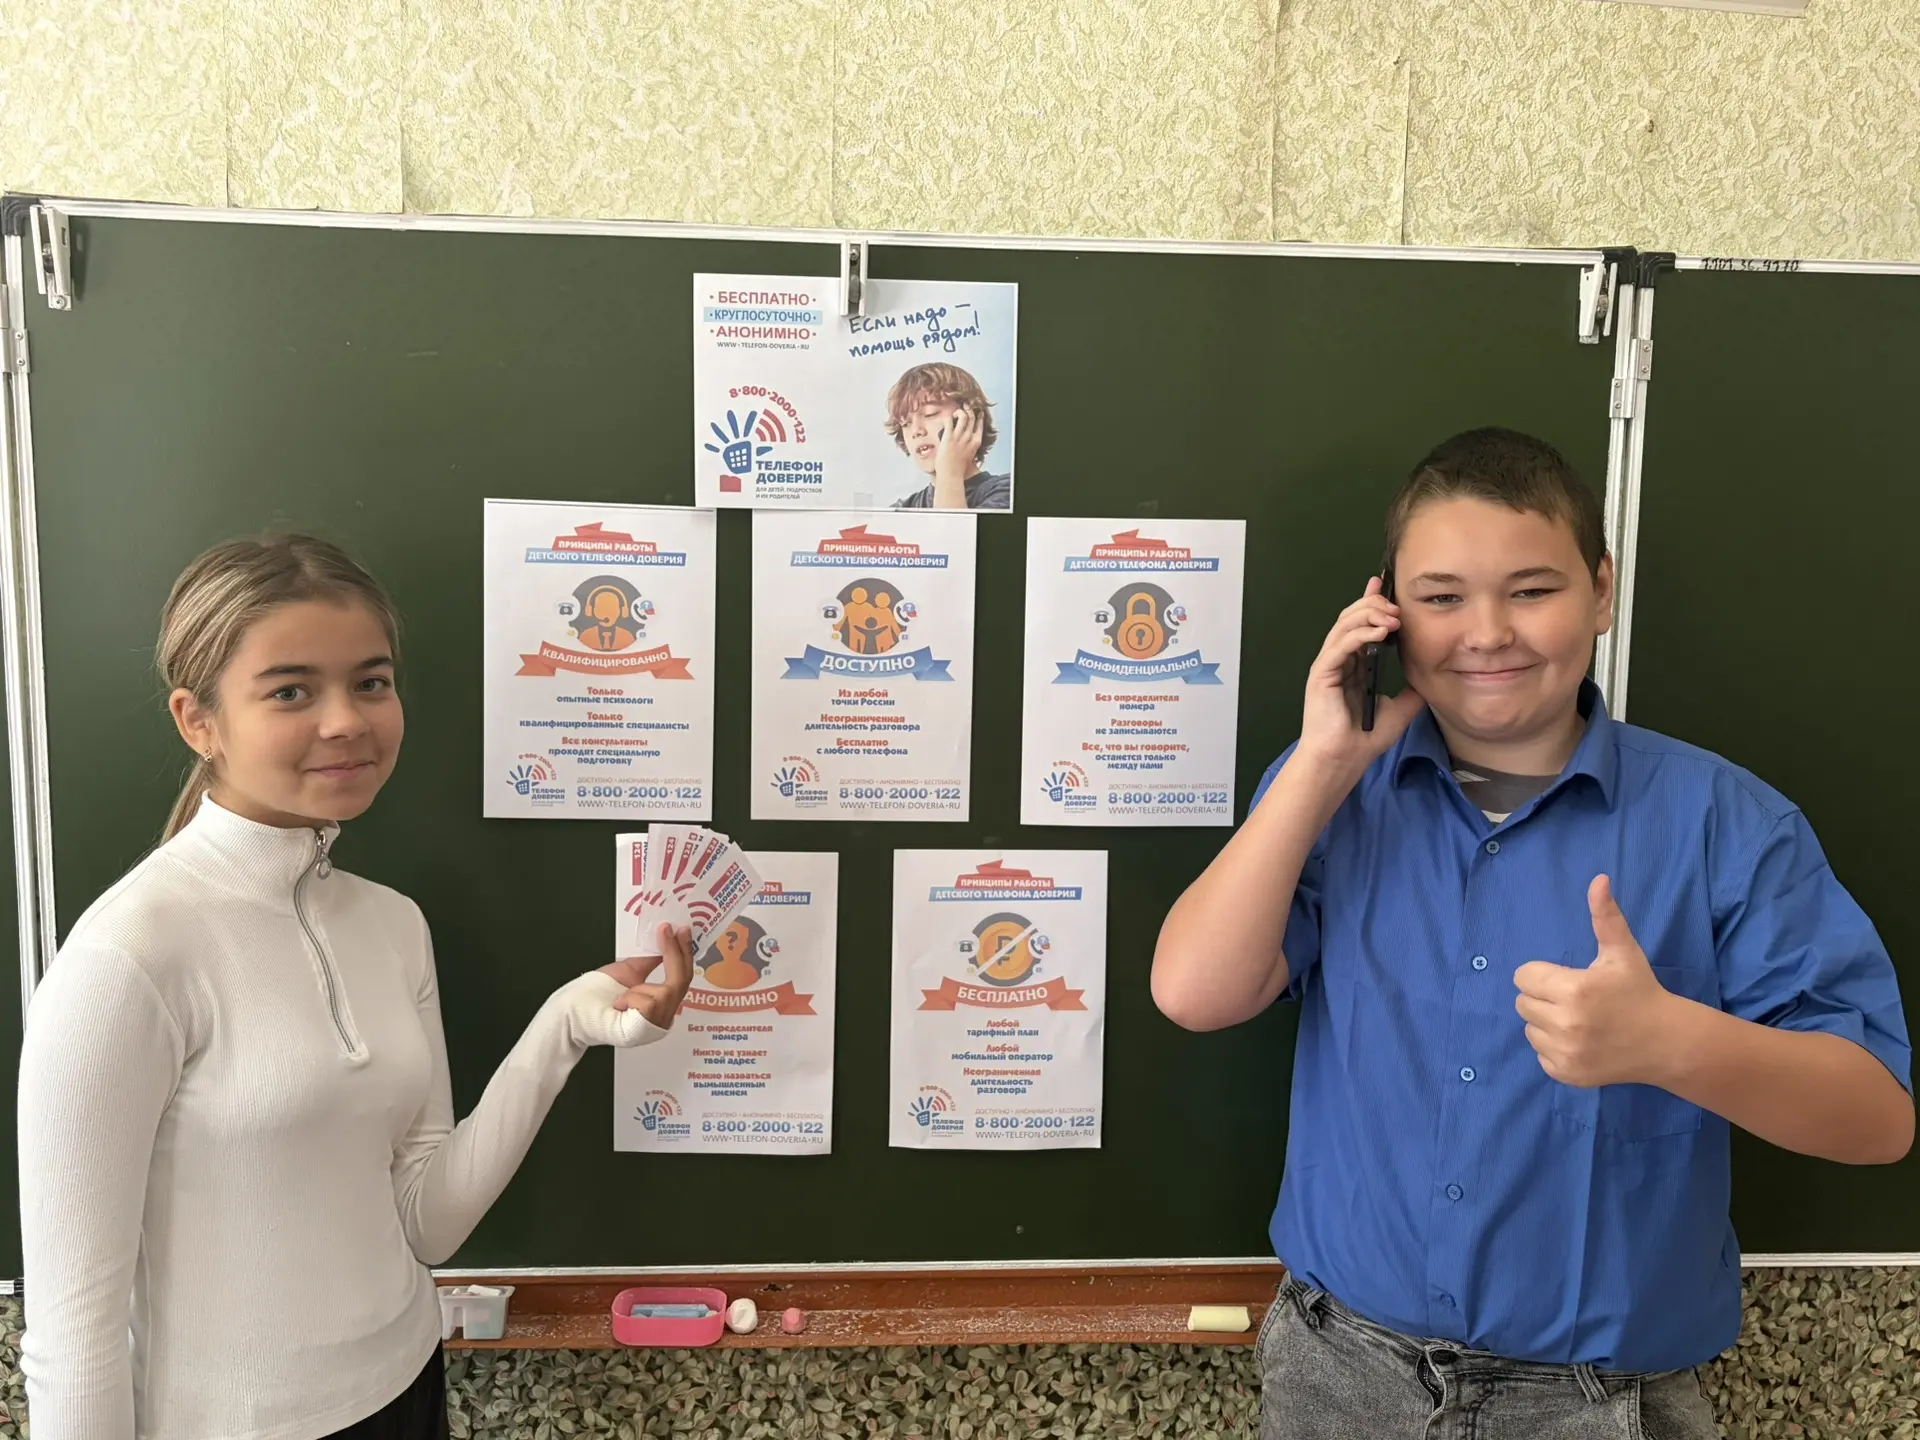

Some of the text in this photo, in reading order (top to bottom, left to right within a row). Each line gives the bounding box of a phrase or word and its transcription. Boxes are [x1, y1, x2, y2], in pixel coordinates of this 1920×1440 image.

[719, 292, 809, 305] БЕСПЛАТНО
[715, 310, 811, 322] КРУГЛОСУТОЧНО
[849, 316, 896, 333] Если
[904, 307, 946, 331] надо
[717, 326, 810, 339] АНОНИМНО
[850, 311, 980, 357] помощь рядом!
[756, 461, 822, 471] ТЕЛЕФОН
[756, 473, 822, 484] ДОВЕРИЯ
[559, 541, 653, 552] ПРИНЦИПЫ РАБОТЫ
[824, 544, 916, 554] ПРИНЦИПЫ РАБОТЫ
[528, 552, 683, 564] ДЕТСКОГО ТЕЛЕФОНА ДОВЕРИЯ
[1096, 549, 1187, 558] ПРИНЦИПЫ РАБОТЫ
[794, 555, 945, 566] ДЕТСКОГО ТЕЛЕФОНА ДОВЕРИЯ
[1070, 561, 1212, 570] ДЕТСКОГО ТЕЛЕФОНА ДОВЕРИЯ
[543, 648, 668, 668] КВАЛИФИЦИРОВАННО
[820, 655, 915, 671] ДОСТУПНО
[1078, 657, 1198, 675] КОНФИДЕНЦИАЛЬНО
[587, 687, 623, 696] Только
[839, 689, 888, 698] Из любой
[1096, 694, 1111, 702] Без
[1120, 703, 1154, 711] номера
[587, 712, 623, 721] Только
[821, 714, 905, 723] Неограниченная
[520, 720, 689, 730] квалифицированные специалисты
[805, 723, 920, 732] длительность разговора
[1111, 719, 1162, 727] Разговоры
[562, 737, 647, 746] Все консультанты
[836, 738, 888, 746] Бесплатно
[824, 747, 860, 755] любого
[863, 748, 907, 756] телефона
[1082, 743, 1103, 752] Все,
[1141, 744, 1189, 752] говорите,
[549, 748, 660, 757] проходят специальную
[578, 757, 632, 765] подготовку
[1108, 762, 1138, 770] между
[714, 869, 743, 901] ТЕЛЕФОН
[961, 879, 1050, 887] ПРИНЦИПЫ РАБОТЫ
[936, 890, 1075, 899] ДЕТСКОГО ТЕЛЕФОНА ДОВЕРИЯ
[763, 895, 808, 904] ДОВЕРИЯ
[685, 991, 778, 1007] АНОНИМНО
[957, 987, 1047, 1003] БЕСПЛАТНО
[987, 1020, 1019, 1028] Любой
[707, 1025, 772, 1033] определителя
[967, 1028, 1015, 1037] тарифный
[712, 1033, 748, 1041] номера
[986, 1044, 1019, 1052] Любой
[704, 1057, 725, 1065] твой
[951, 1053, 1053, 1061] мобильный оператор
[688, 1072, 721, 1080] Можно
[963, 1068, 1041, 1077] Неограниченная
[694, 1081, 765, 1089] вымышленным
[971, 1078, 1033, 1086] длительность
[977, 1086, 1026, 1094] разговора
